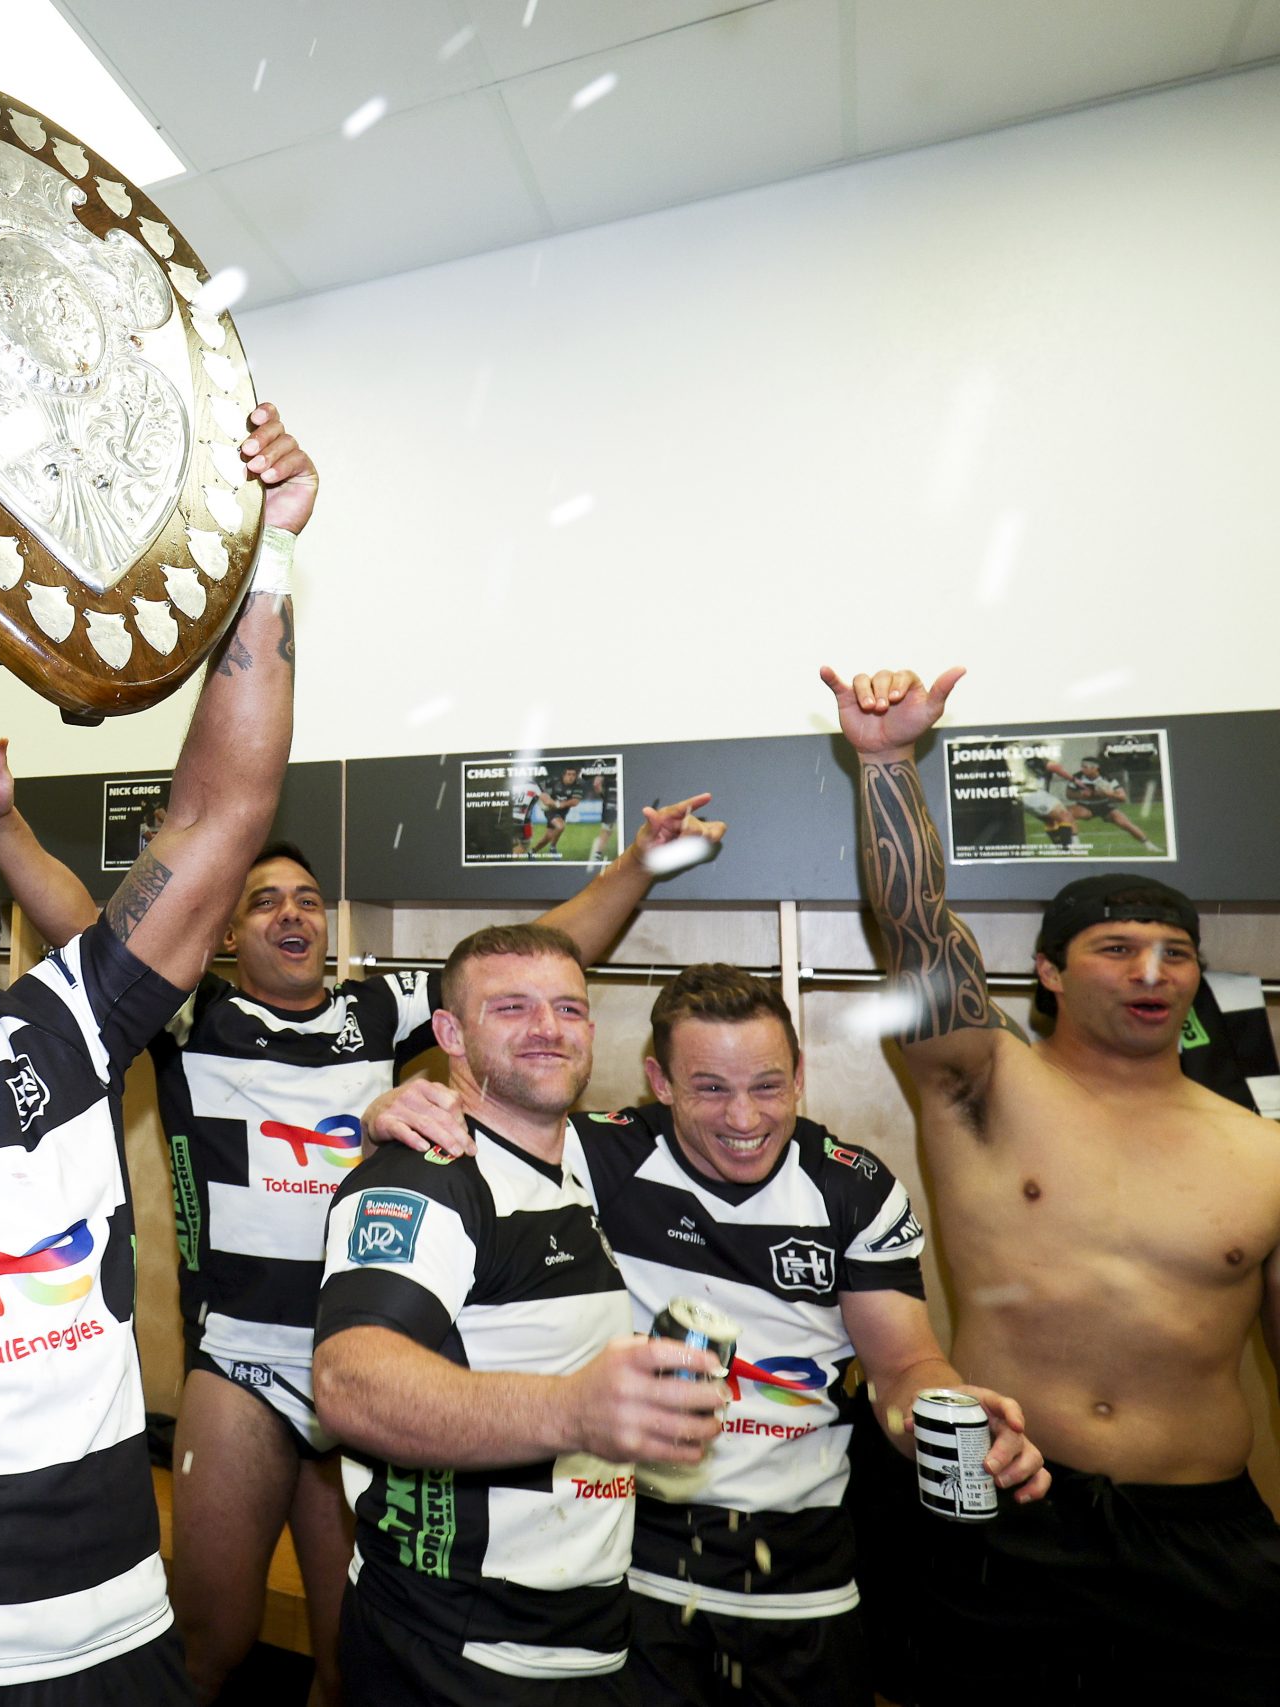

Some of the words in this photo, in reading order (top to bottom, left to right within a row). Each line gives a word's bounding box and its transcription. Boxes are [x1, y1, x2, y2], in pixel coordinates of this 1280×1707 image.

[952, 748, 1010, 765] JONAH
[1011, 745, 1062, 759] LOWE
[467, 768, 506, 779] CHASE
[955, 771, 987, 780] MAGPIE
[109, 787, 131, 796] NICK
[132, 785, 161, 795] GRIGG
[954, 786, 1020, 800] WINGER
[365, 1200, 414, 1216] BUNNINGS
[667, 1228, 707, 1246] oneills
